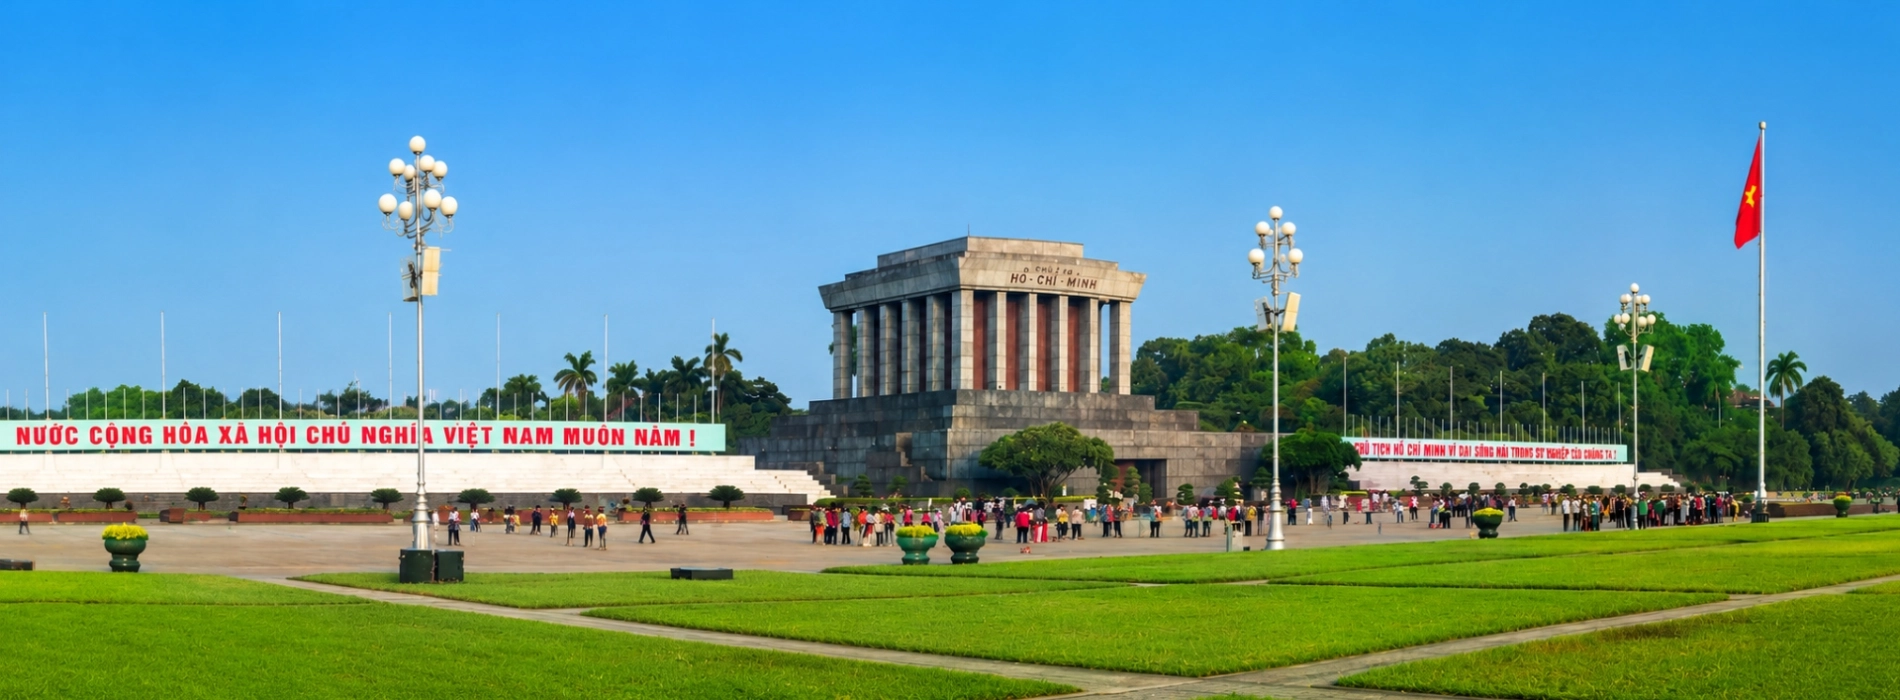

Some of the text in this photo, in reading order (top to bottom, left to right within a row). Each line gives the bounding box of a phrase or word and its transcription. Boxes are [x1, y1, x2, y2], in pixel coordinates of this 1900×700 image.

[1066, 277, 1098, 290] MINH
[16, 423, 78, 445] NƯỚC
[89, 422, 152, 449] CỘNG
[258, 421, 296, 448] HỘI
[444, 421, 492, 448] VIỆT
[503, 427, 553, 445] NAM
[563, 424, 624, 446] MUÔN
[690, 429, 696, 447] !
